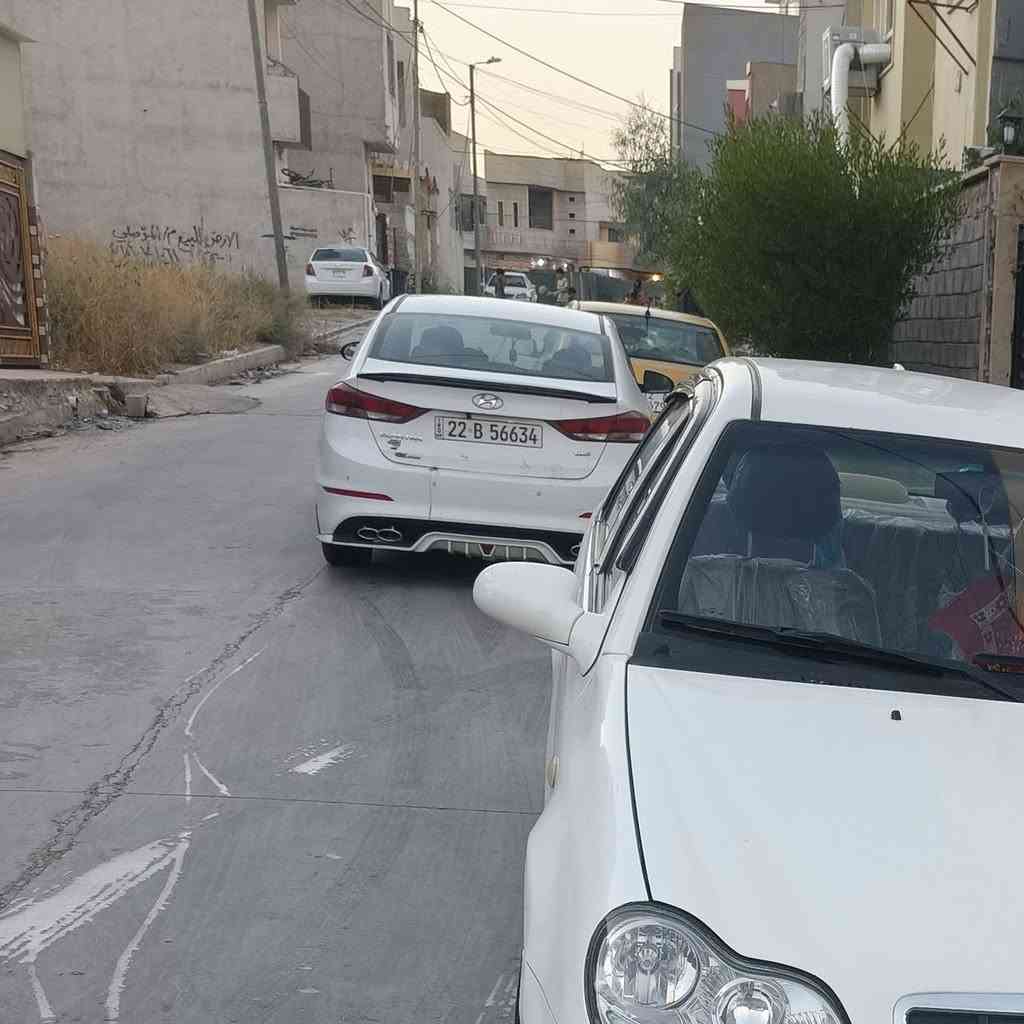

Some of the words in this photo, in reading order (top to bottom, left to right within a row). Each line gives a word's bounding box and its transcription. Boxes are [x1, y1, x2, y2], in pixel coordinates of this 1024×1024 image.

[447, 420, 467, 439] 22
[473, 422, 484, 440] B
[489, 424, 538, 445] 56634
